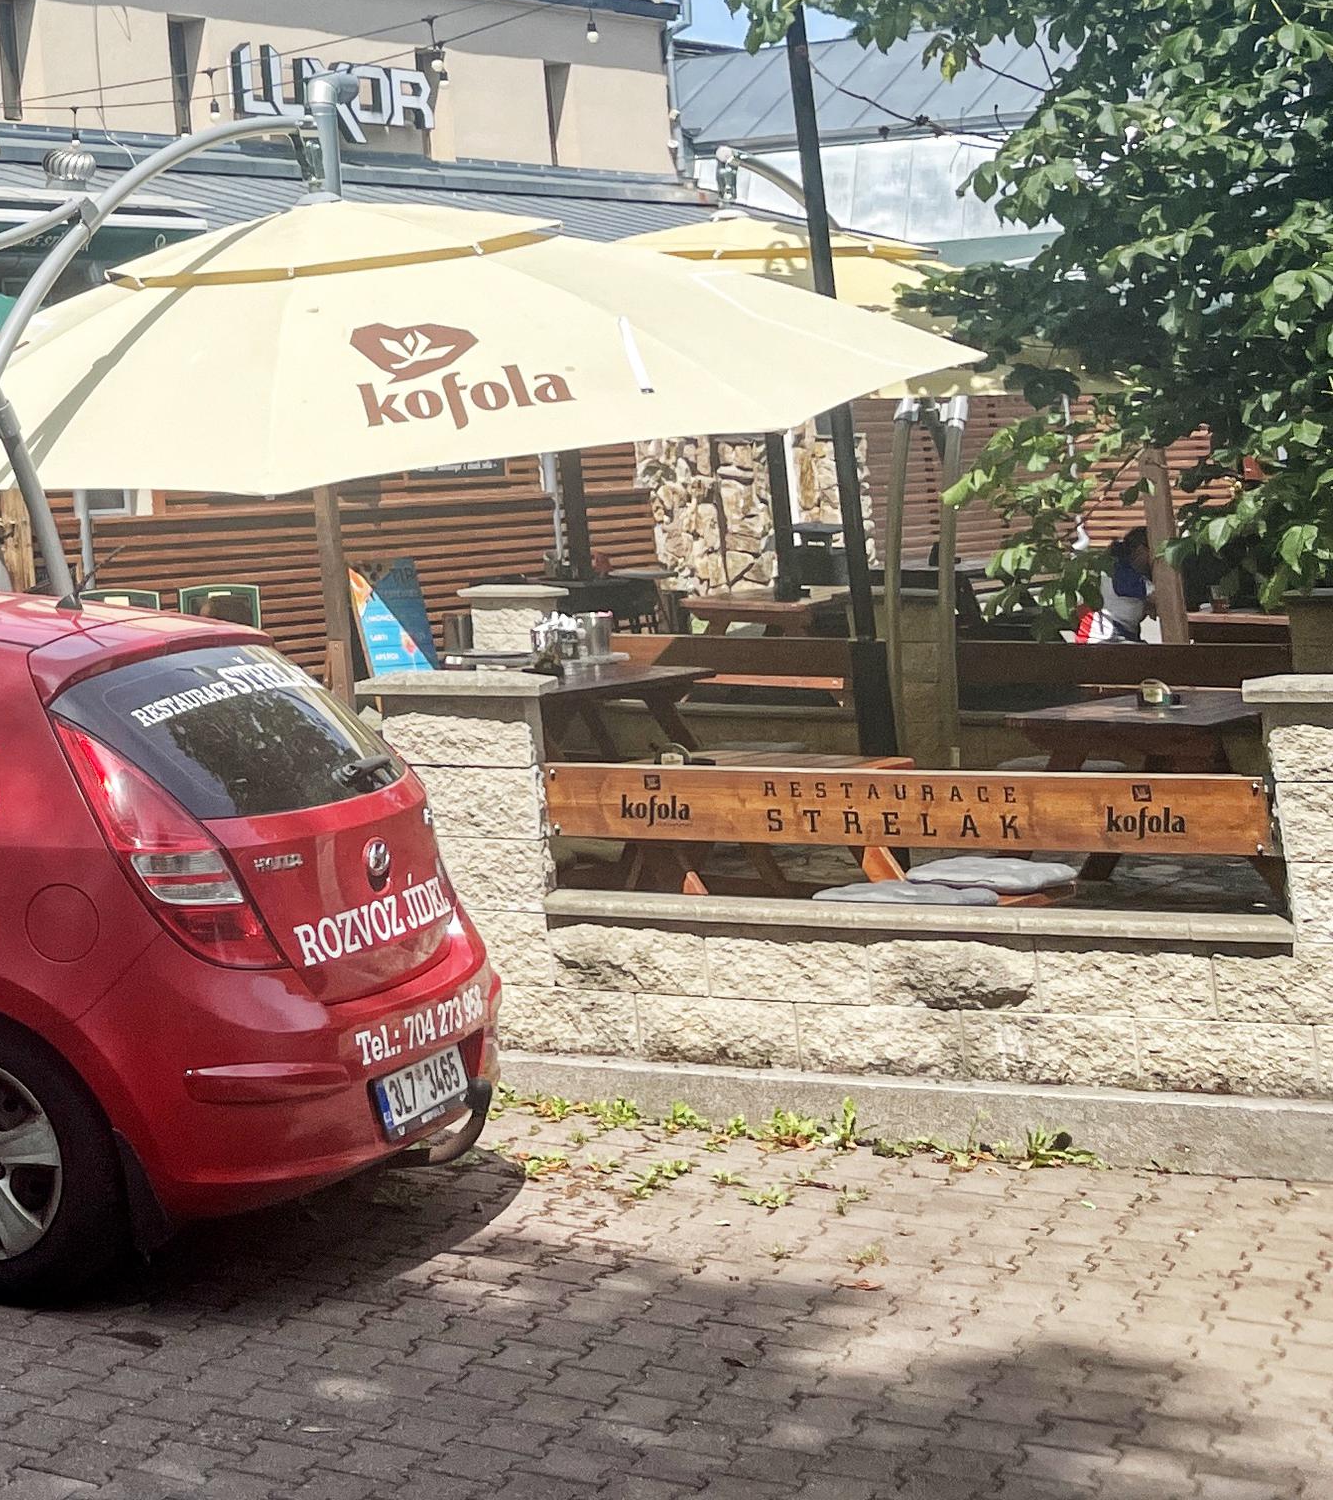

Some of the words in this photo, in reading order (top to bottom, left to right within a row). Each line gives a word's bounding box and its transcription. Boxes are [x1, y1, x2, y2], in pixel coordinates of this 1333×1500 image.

[356, 365, 577, 429] kofola
[131, 681, 235, 727] RESTAURACE
[621, 794, 690, 827] kofola
[763, 781, 1016, 803] RESTAURACE
[766, 805, 1021, 839] STŘELÁK
[1106, 806, 1185, 840] kofola
[293, 894, 406, 967] ROZVOZ
[402, 873, 452, 929] JÍDEL
[355, 1025, 402, 1066] Tel.:
[403, 1008, 437, 1049] 704
[437, 997, 463, 1037] 273
[462, 984, 483, 1023] 958
